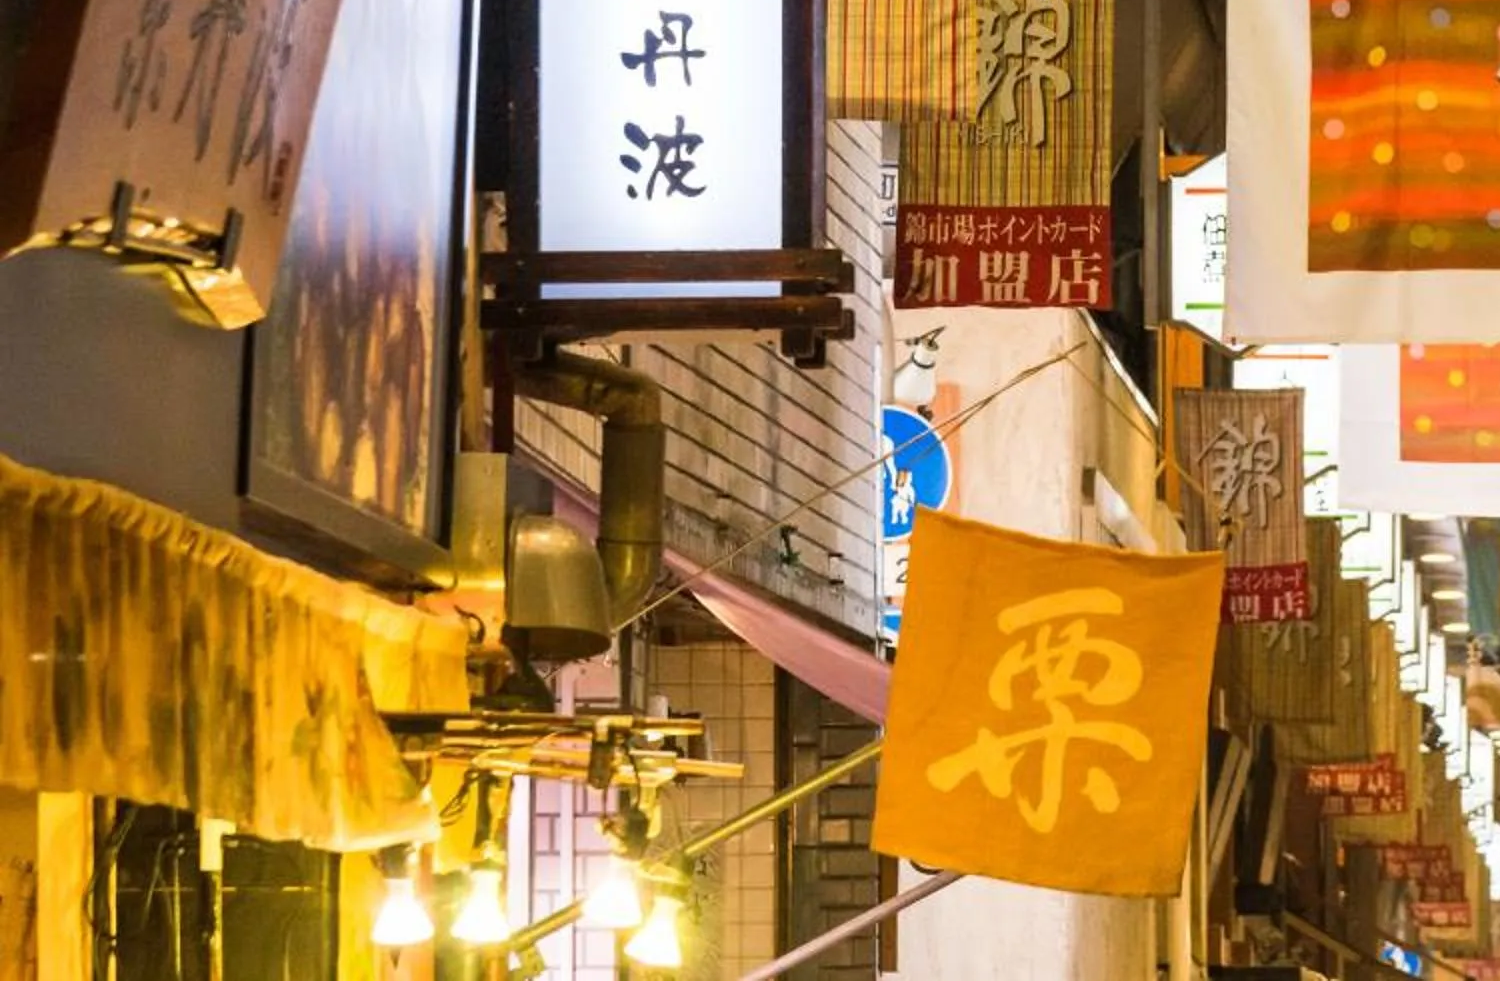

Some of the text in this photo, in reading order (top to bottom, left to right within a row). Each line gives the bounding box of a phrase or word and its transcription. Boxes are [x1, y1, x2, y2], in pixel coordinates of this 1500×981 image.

[904, 210, 1102, 245] 錦市場ポイントカード
[906, 247, 1104, 306] 加盟店
[1197, 412, 1284, 531] 錦
[926, 587, 1153, 834] 栗
